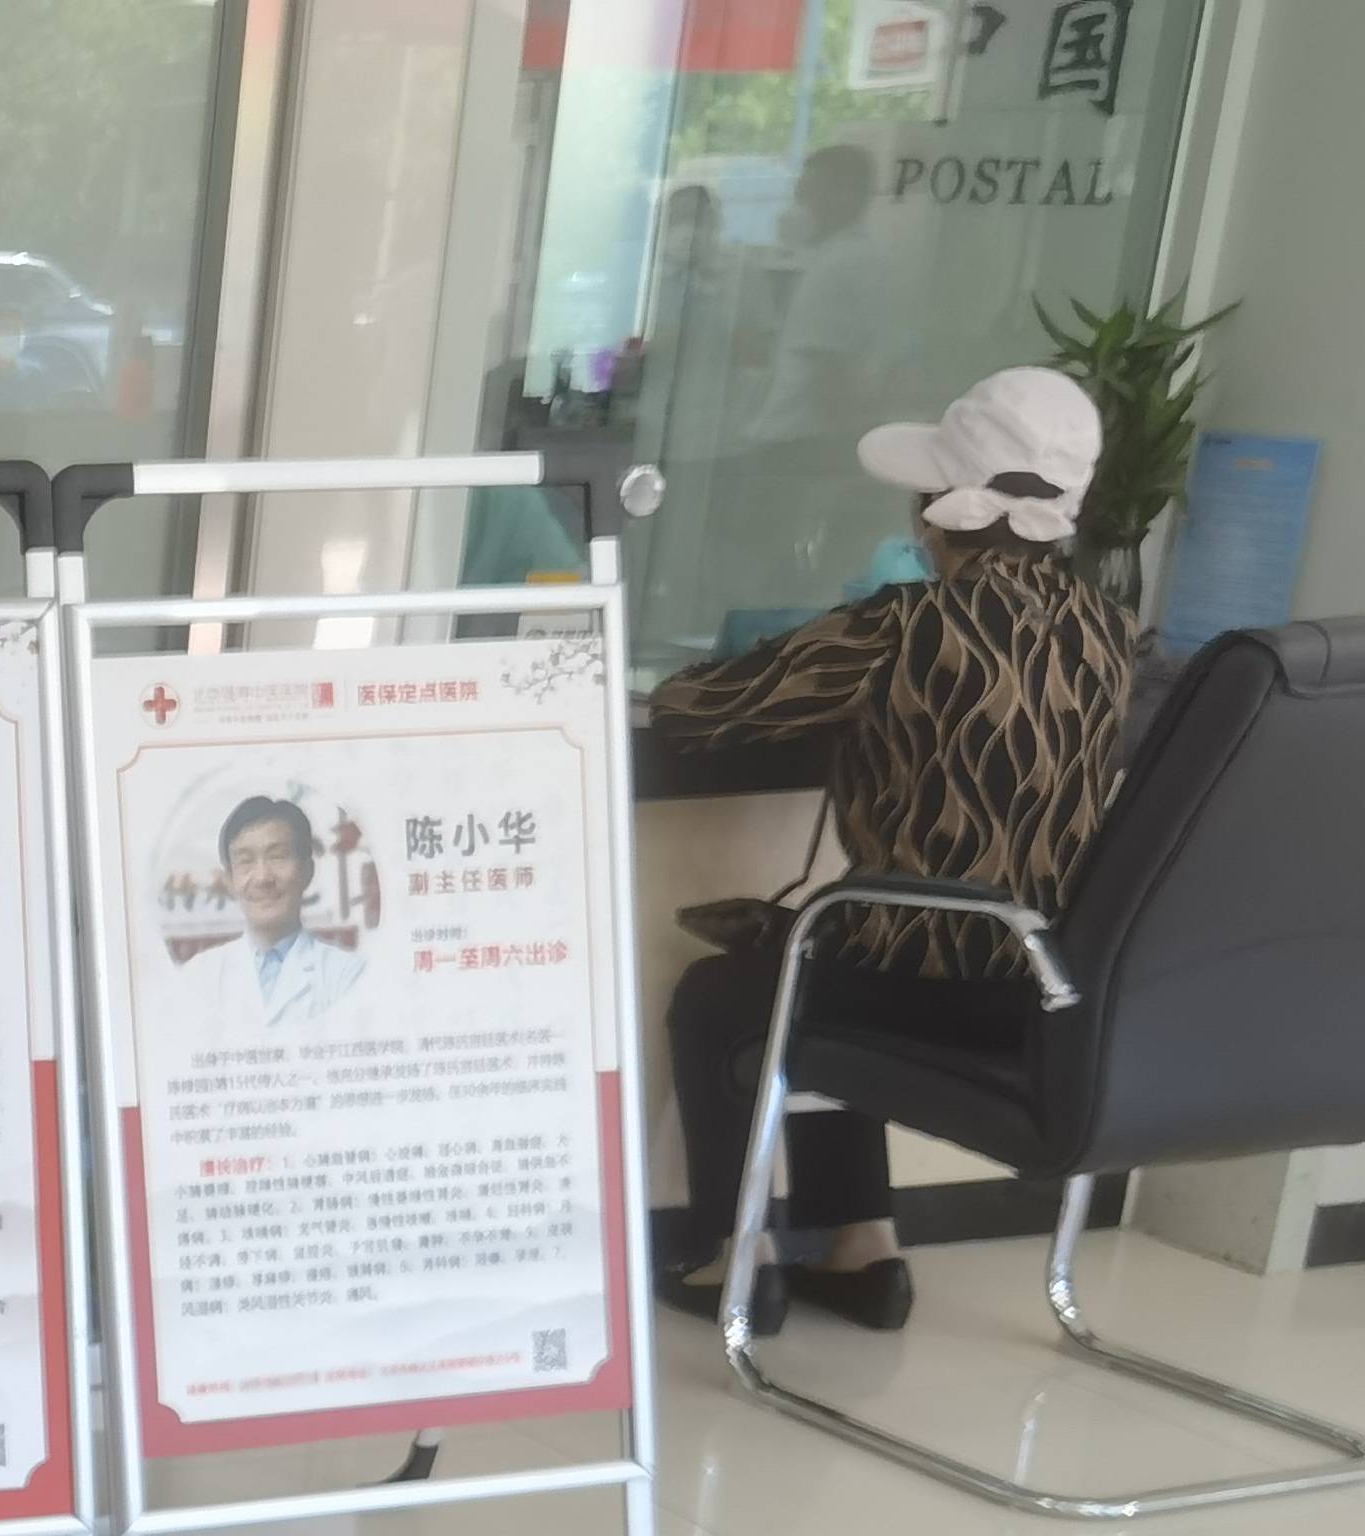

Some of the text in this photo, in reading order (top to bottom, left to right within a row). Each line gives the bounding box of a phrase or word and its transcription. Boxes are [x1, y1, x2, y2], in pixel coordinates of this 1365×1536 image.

[890, 157, 1114, 206] POSTAL
[405, 810, 537, 861] 陈小华
[407, 866, 536, 897] 副主任医师
[412, 940, 569, 974] 周一至周六出诊
